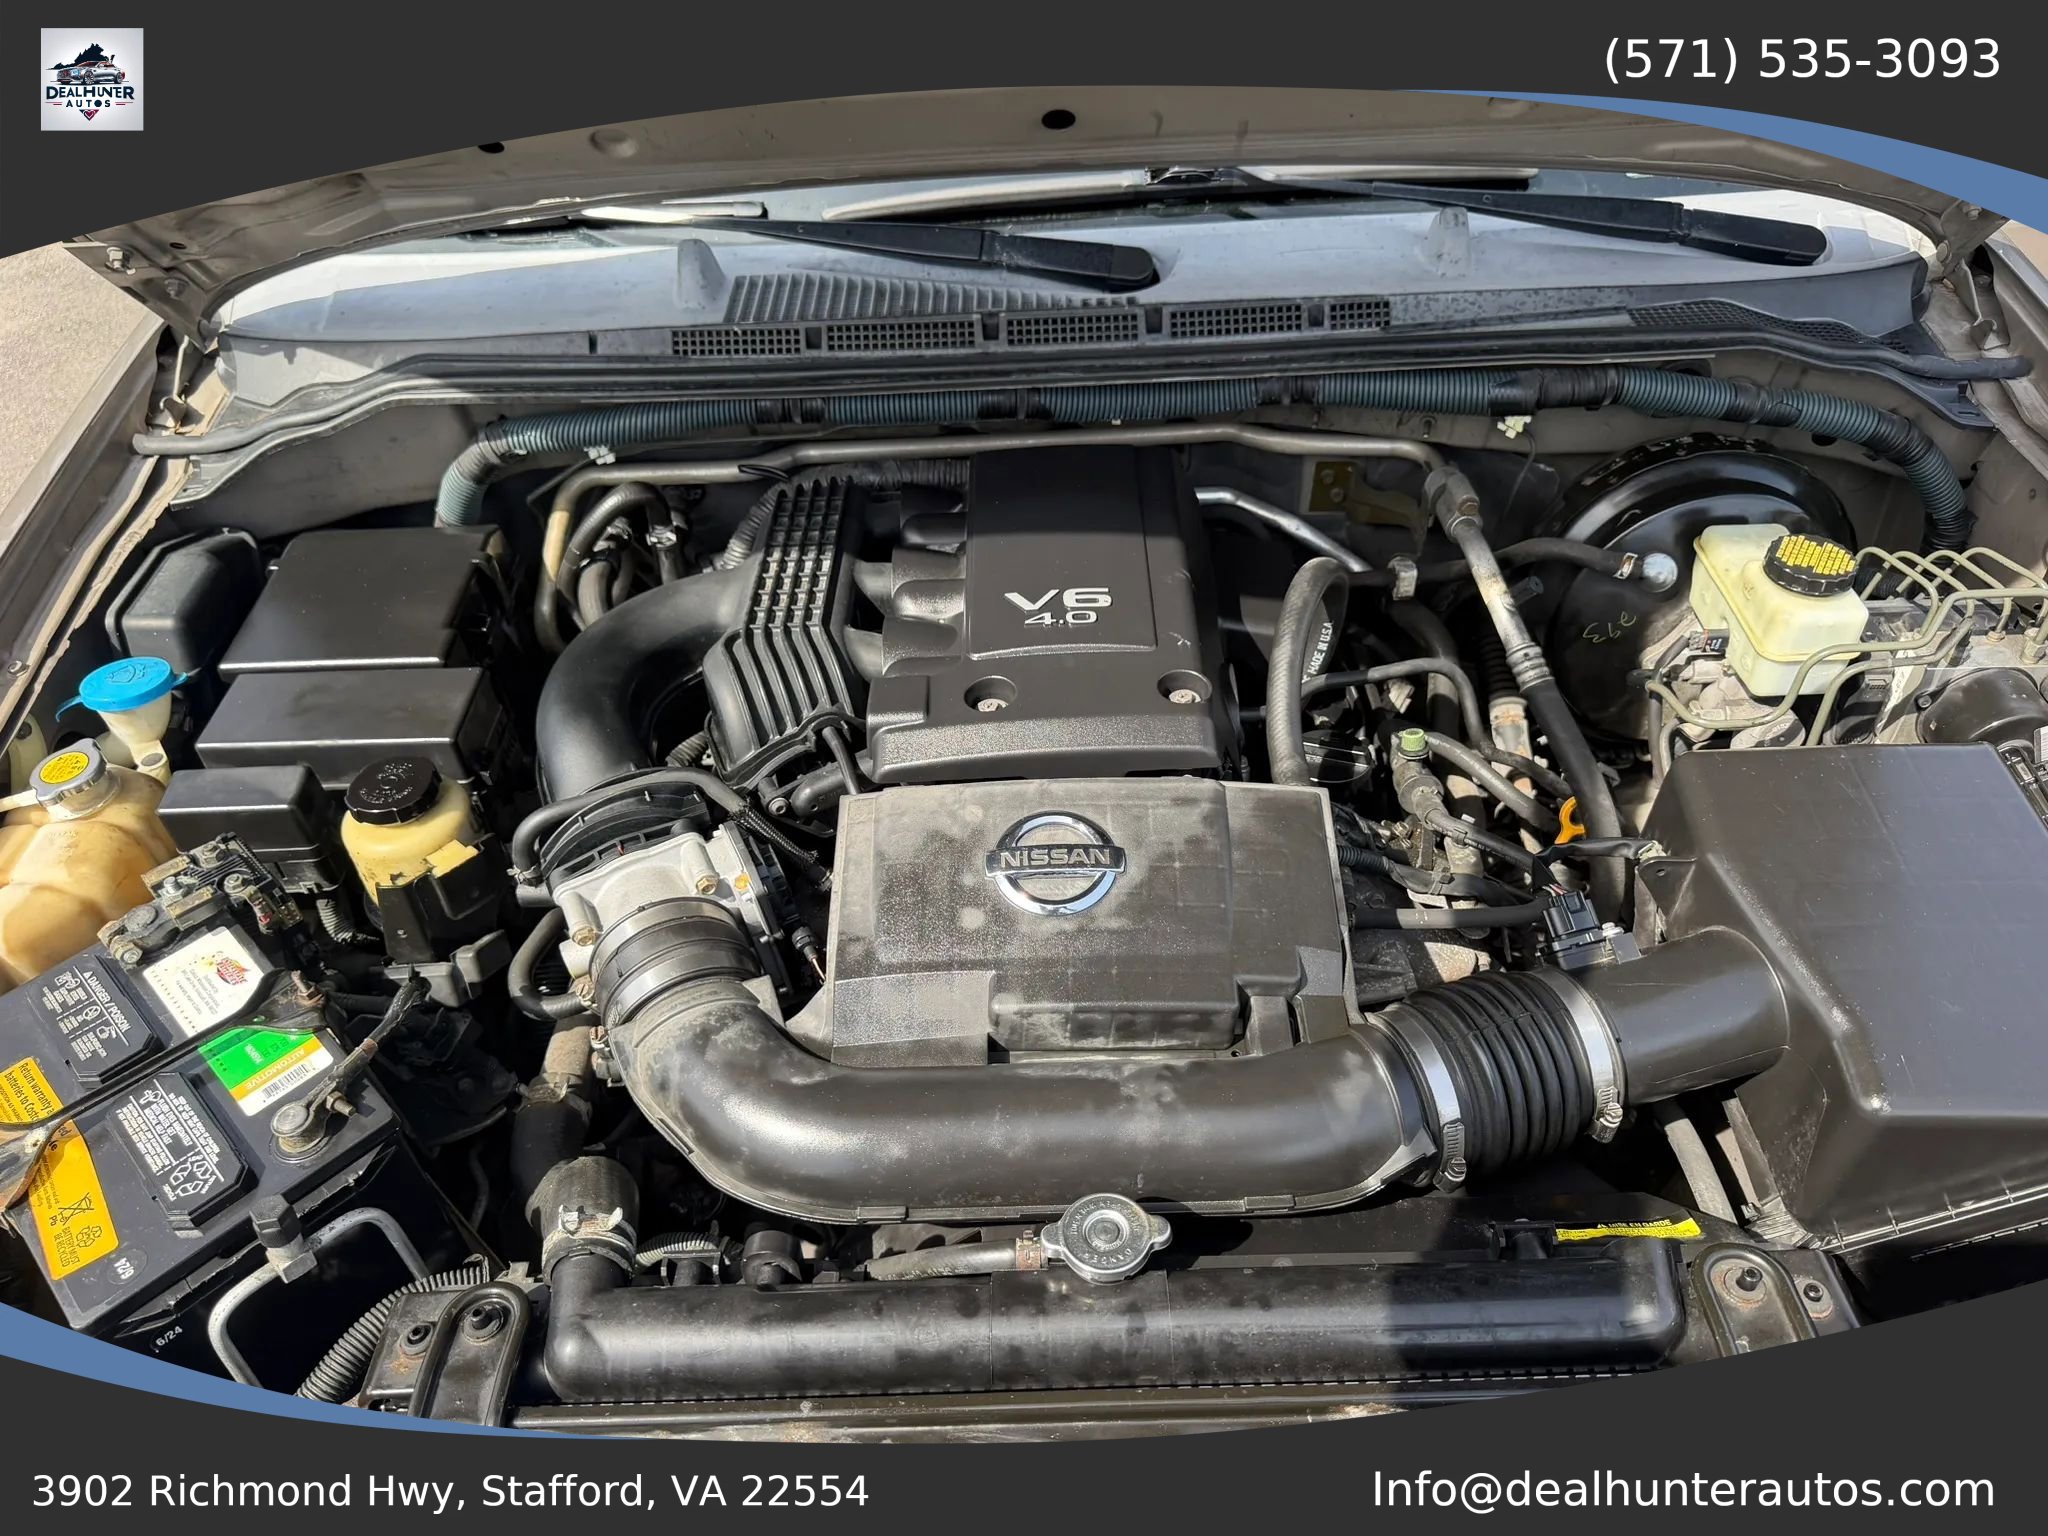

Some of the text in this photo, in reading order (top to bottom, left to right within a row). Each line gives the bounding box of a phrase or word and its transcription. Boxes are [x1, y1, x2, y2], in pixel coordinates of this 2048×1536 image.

[1003, 586, 1112, 611] V6
[1023, 609, 1098, 627] 4.0
[1307, 651, 1324, 674] MADE
[999, 847, 1111, 868] NISSAN
[243, 1047, 305, 1089] AUTOMOTIVE
[4, 1070, 25, 1098] batteries
[20, 1095, 29, 1105] to
[19, 1062, 36, 1085] Return
[31, 1082, 53, 1111] warranty
[47, 1214, 59, 1226] Pb
[1641, 1218, 1672, 1228] GARDE
[55, 1239, 70, 1267] RECYCLED
[61, 1225, 81, 1264] BATTERY MUST
[155, 1325, 182, 1345] 6/24
